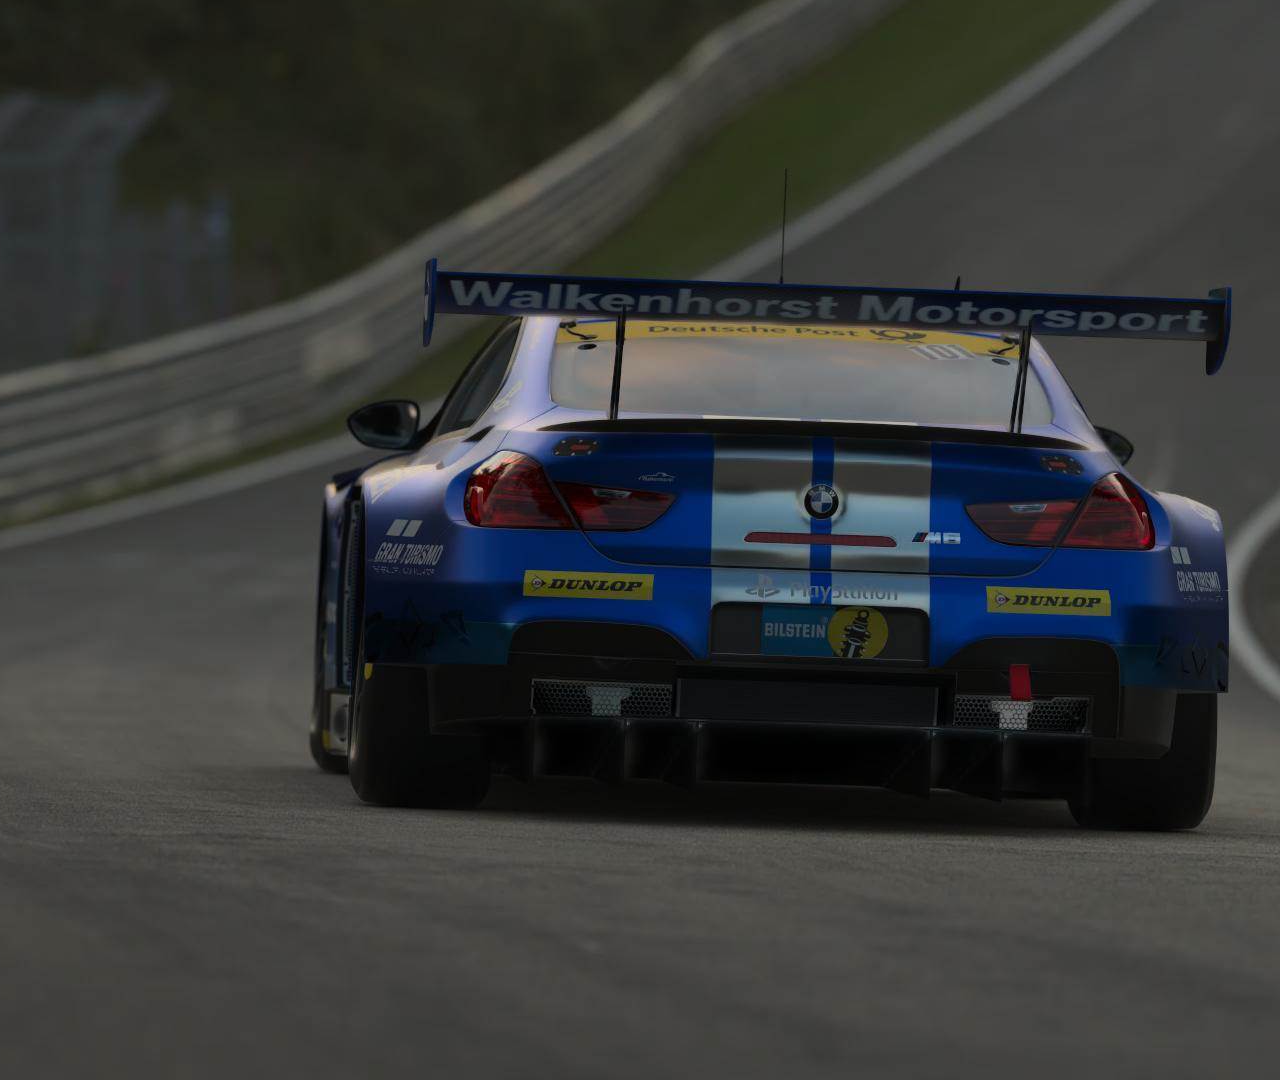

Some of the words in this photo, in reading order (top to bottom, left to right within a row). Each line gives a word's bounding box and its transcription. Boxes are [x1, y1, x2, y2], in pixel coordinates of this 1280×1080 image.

[449, 279, 838, 320] Walkenhorst
[857, 295, 1210, 333] Motorsport
[648, 325, 786, 335] Deutsche
[795, 327, 858, 337] Post
[374, 541, 406, 563] GRAN
[400, 543, 444, 566] TURISMO
[547, 577, 643, 593] DUNLOP
[790, 582, 899, 604] PlayStation
[1012, 594, 1101, 609] DUNLOP
[764, 622, 827, 639] BILSTEIN
